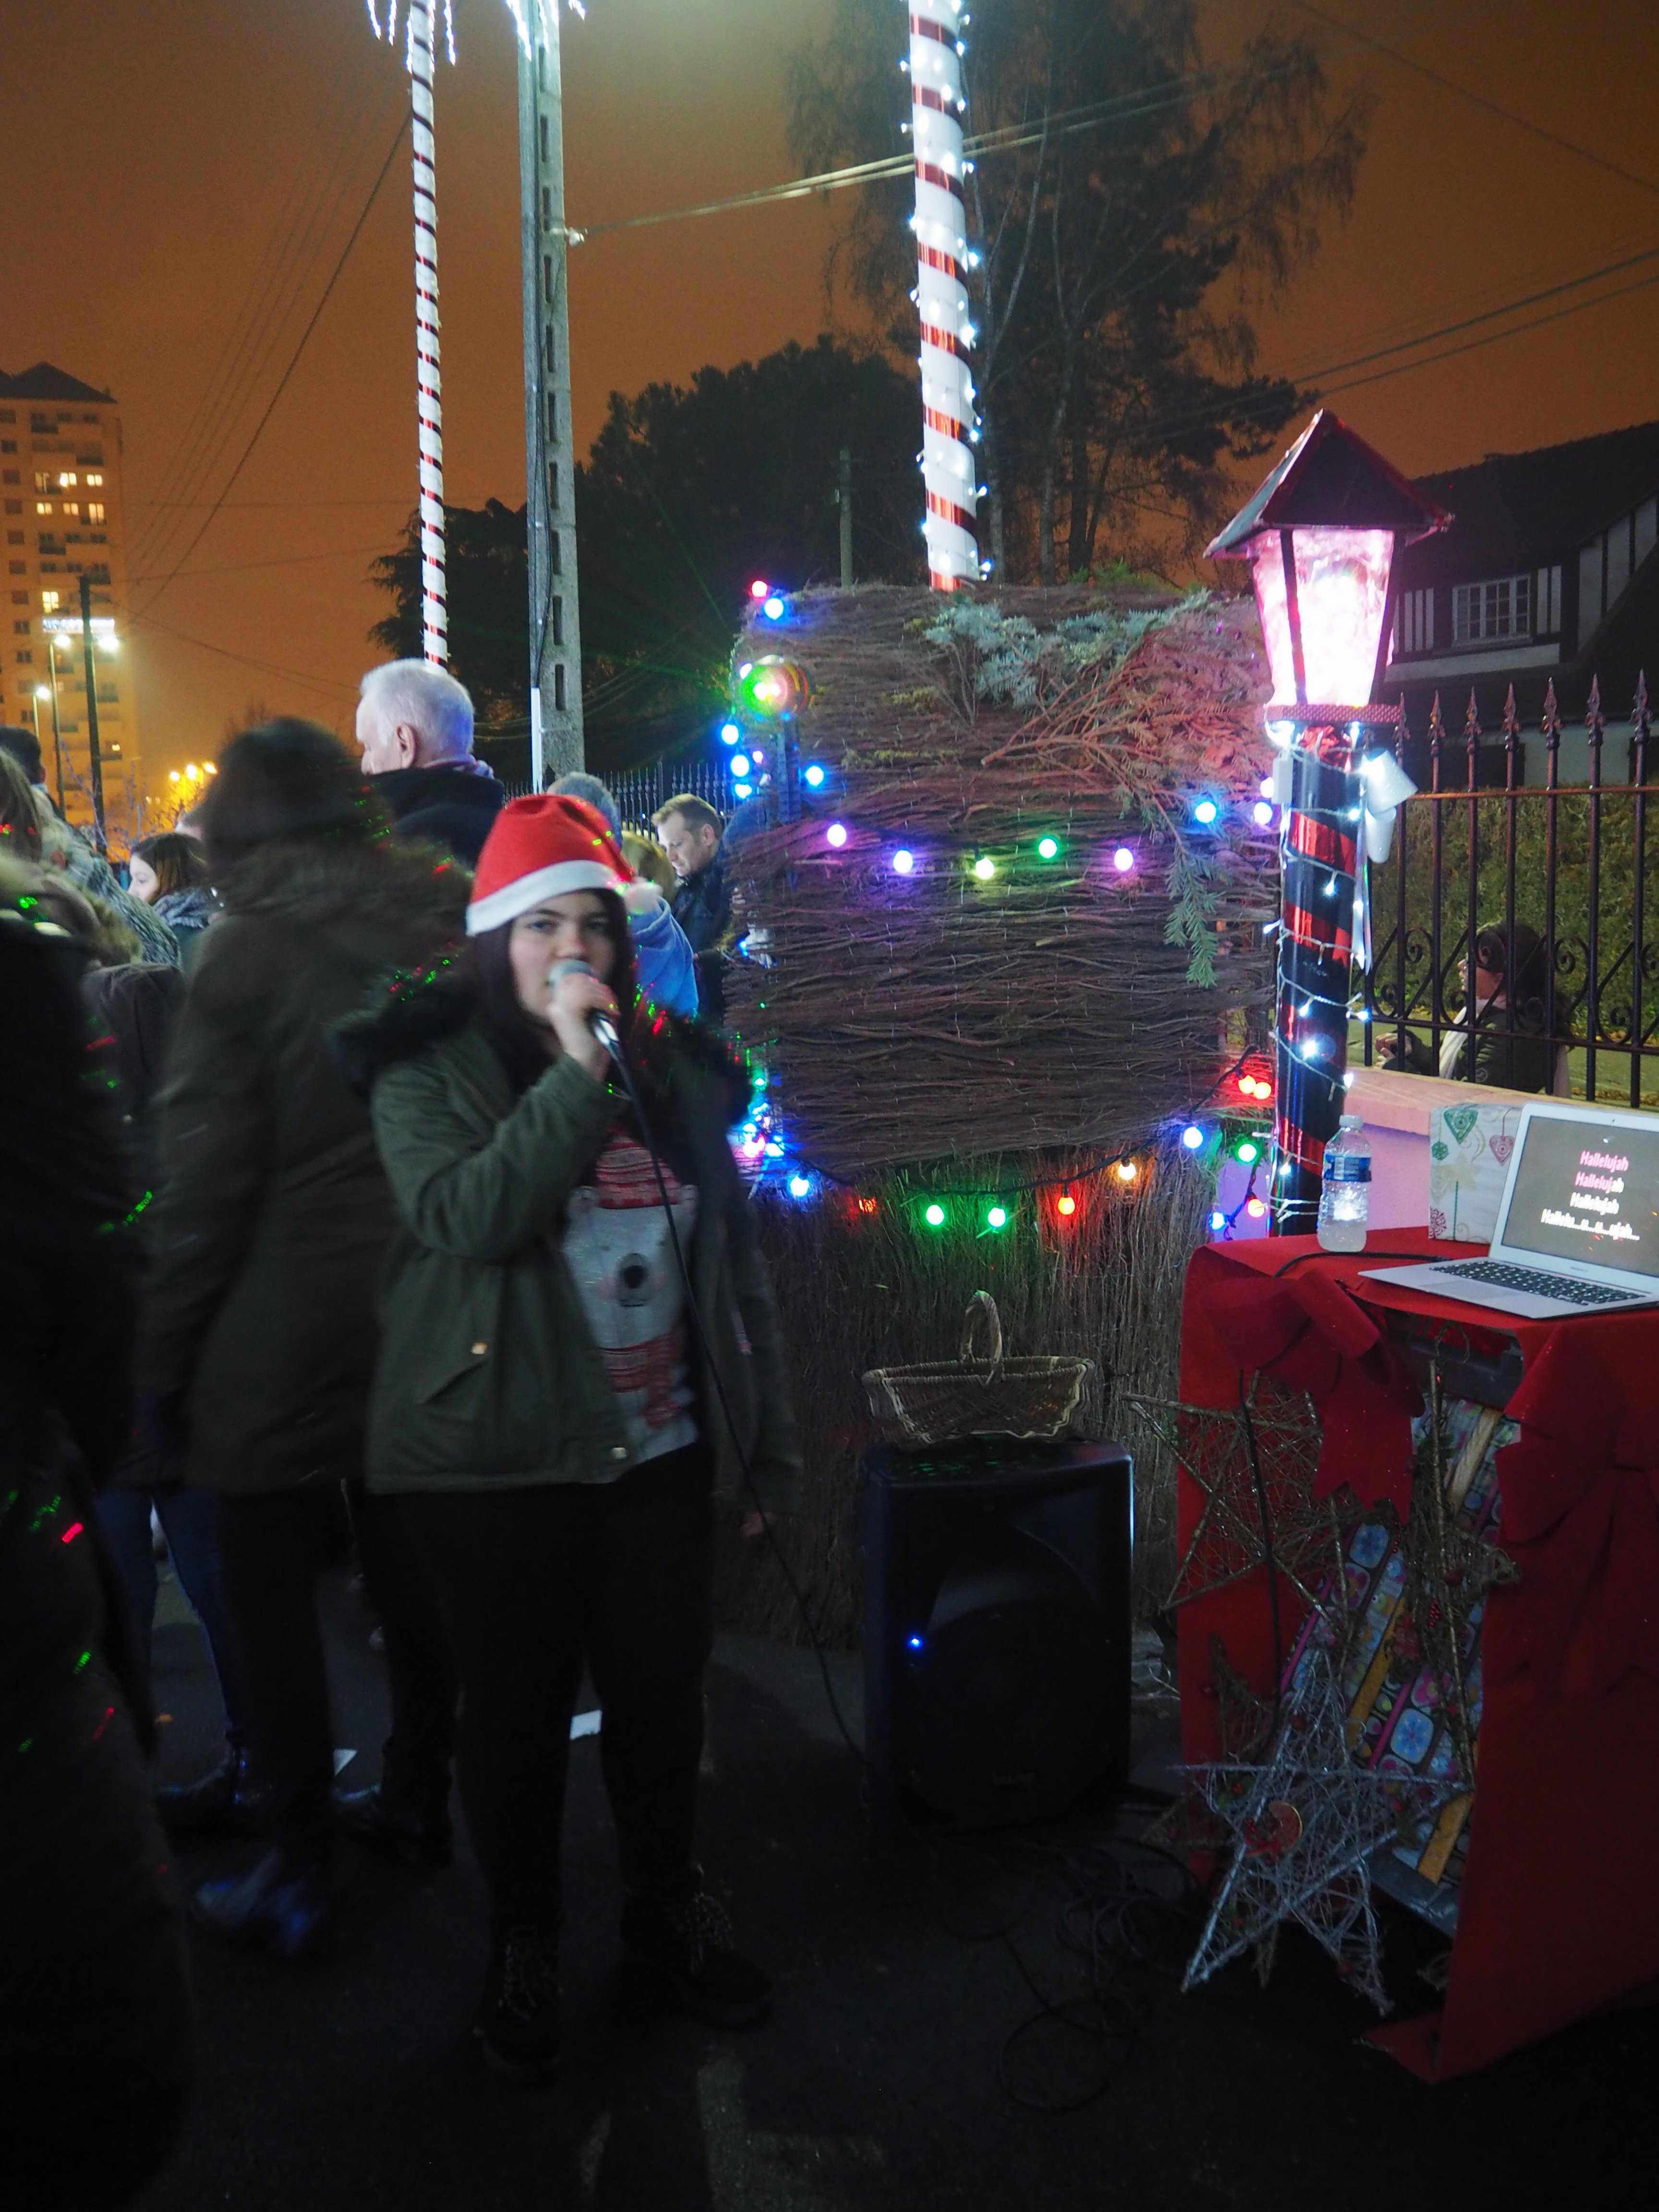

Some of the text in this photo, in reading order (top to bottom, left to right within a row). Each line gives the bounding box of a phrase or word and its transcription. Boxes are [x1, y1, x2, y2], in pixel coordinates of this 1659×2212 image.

[1580, 1150, 1629, 1172] Hallelujah
[1574, 1172, 1624, 1194] Hallelujah
[1570, 1192, 1620, 1215] Hallelujah
